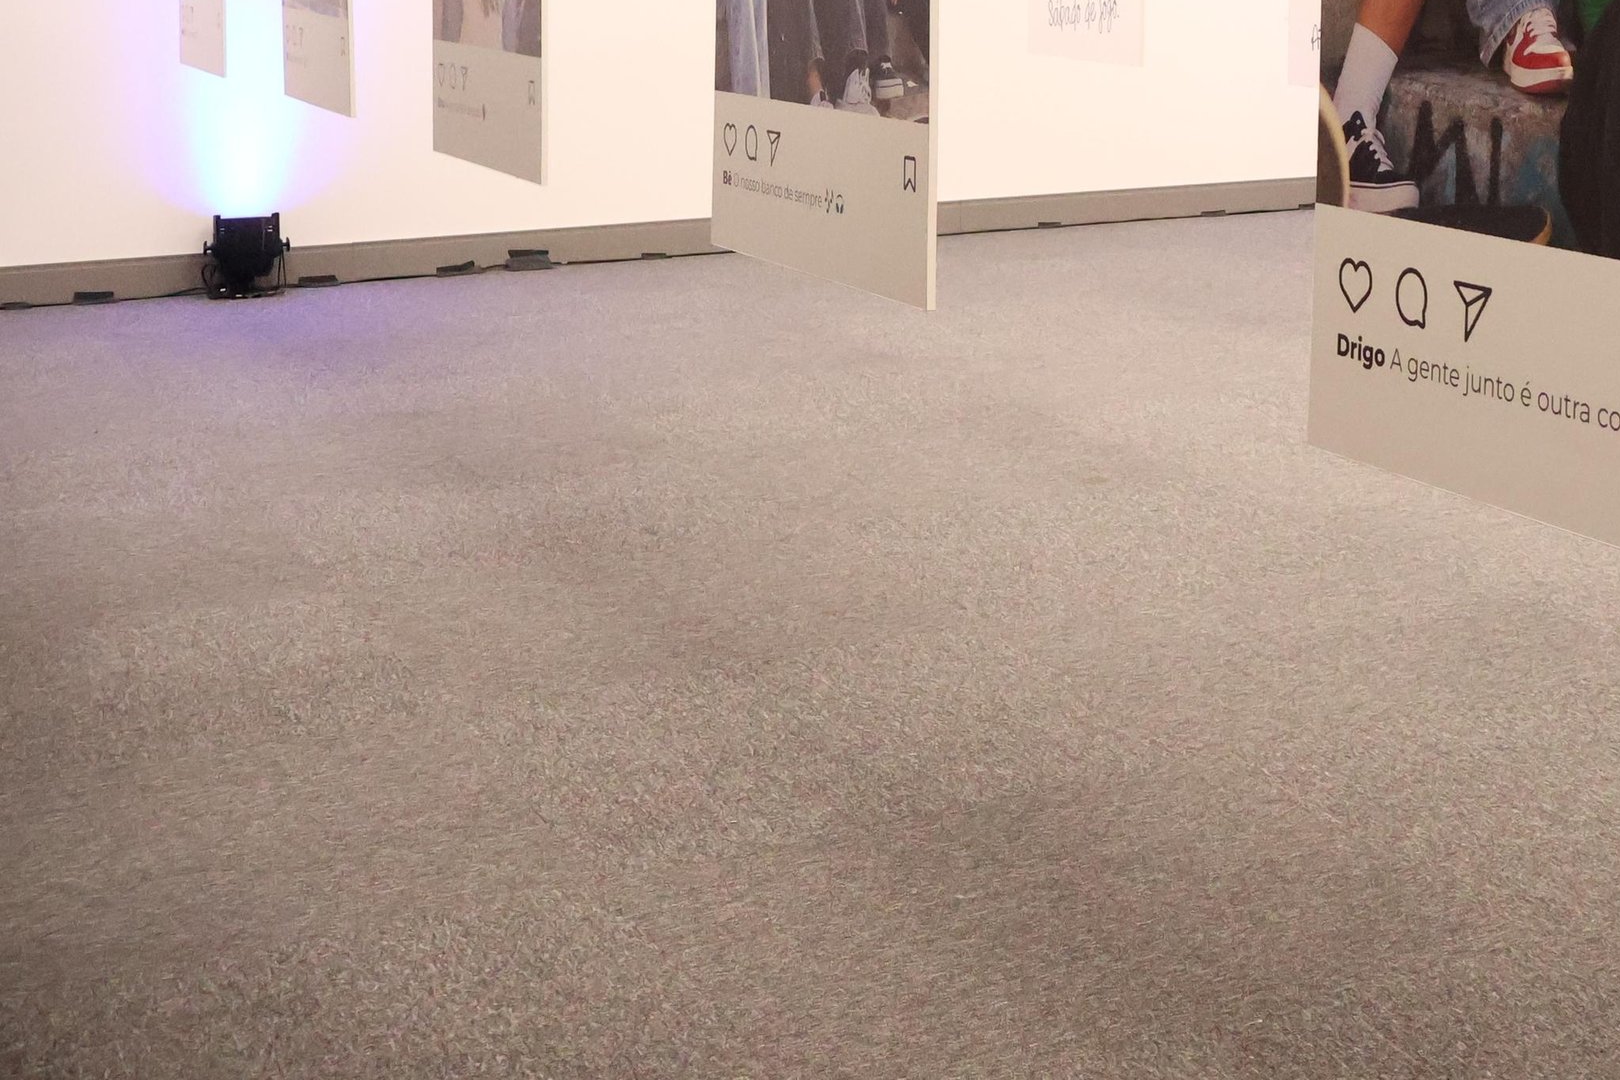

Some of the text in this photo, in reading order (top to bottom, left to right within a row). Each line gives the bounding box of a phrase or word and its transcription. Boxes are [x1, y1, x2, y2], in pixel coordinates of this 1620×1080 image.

[795, 189, 822, 208] sempre
[1336, 332, 1386, 370] Drigo
[1390, 347, 1403, 373] A
[1407, 354, 1460, 389] gente
[1463, 365, 1514, 403] junto
[1519, 380, 1532, 408] é
[1537, 389, 1591, 424] outra
